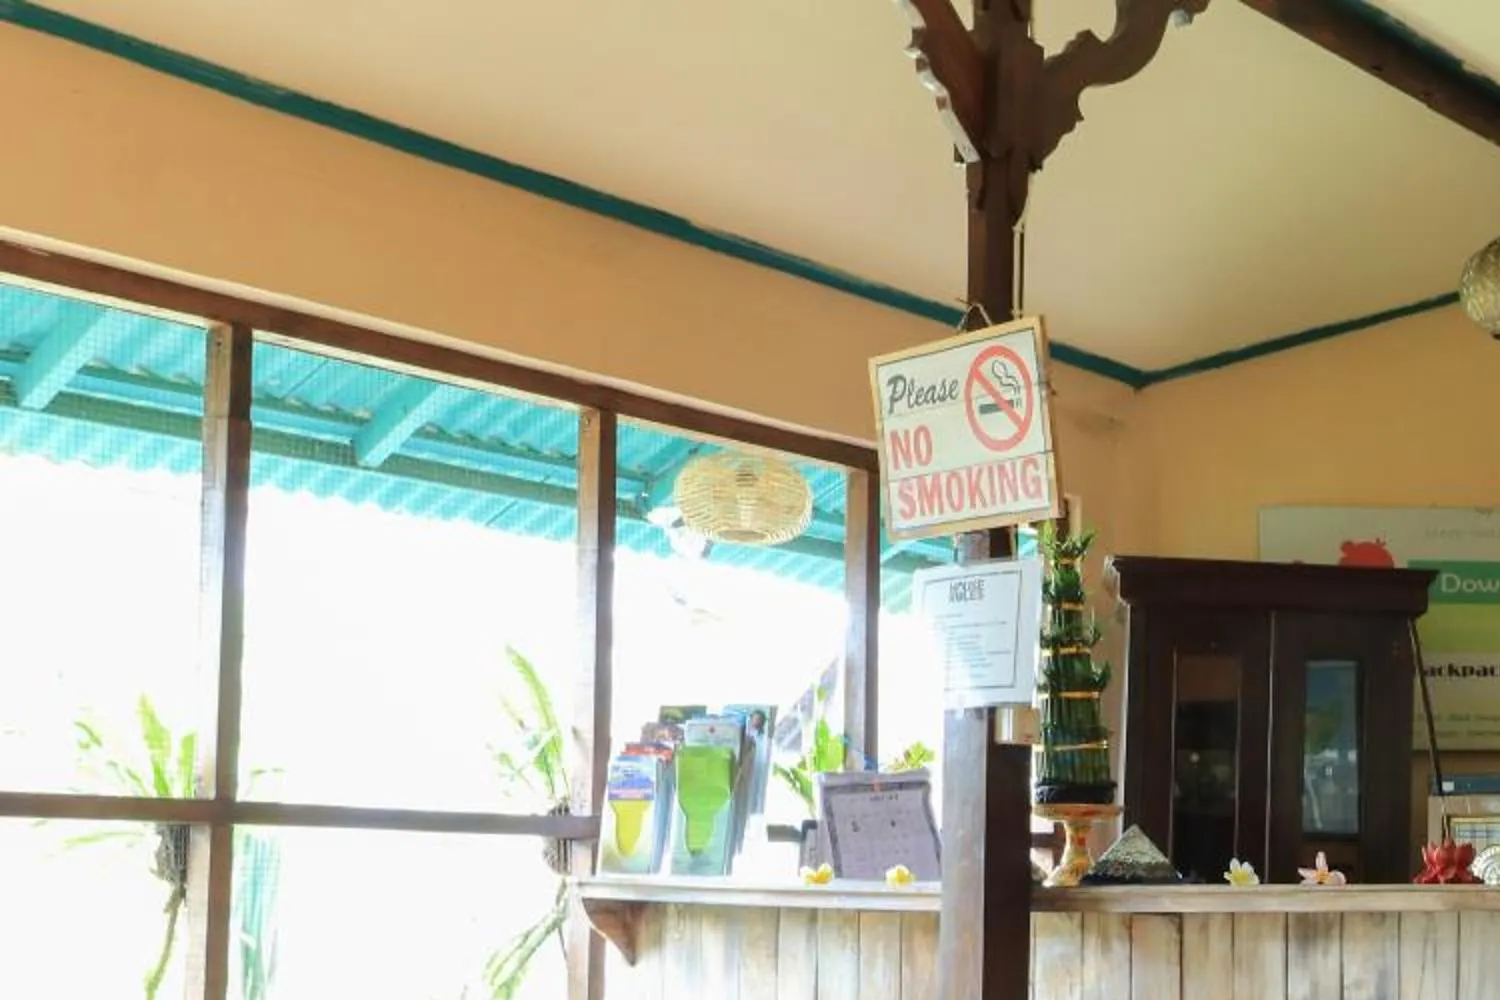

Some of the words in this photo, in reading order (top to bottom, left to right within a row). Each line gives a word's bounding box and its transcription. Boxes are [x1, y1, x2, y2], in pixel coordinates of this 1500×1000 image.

[886, 375, 959, 414] Please
[889, 425, 933, 471] NO
[897, 455, 1042, 520] SMOKING
